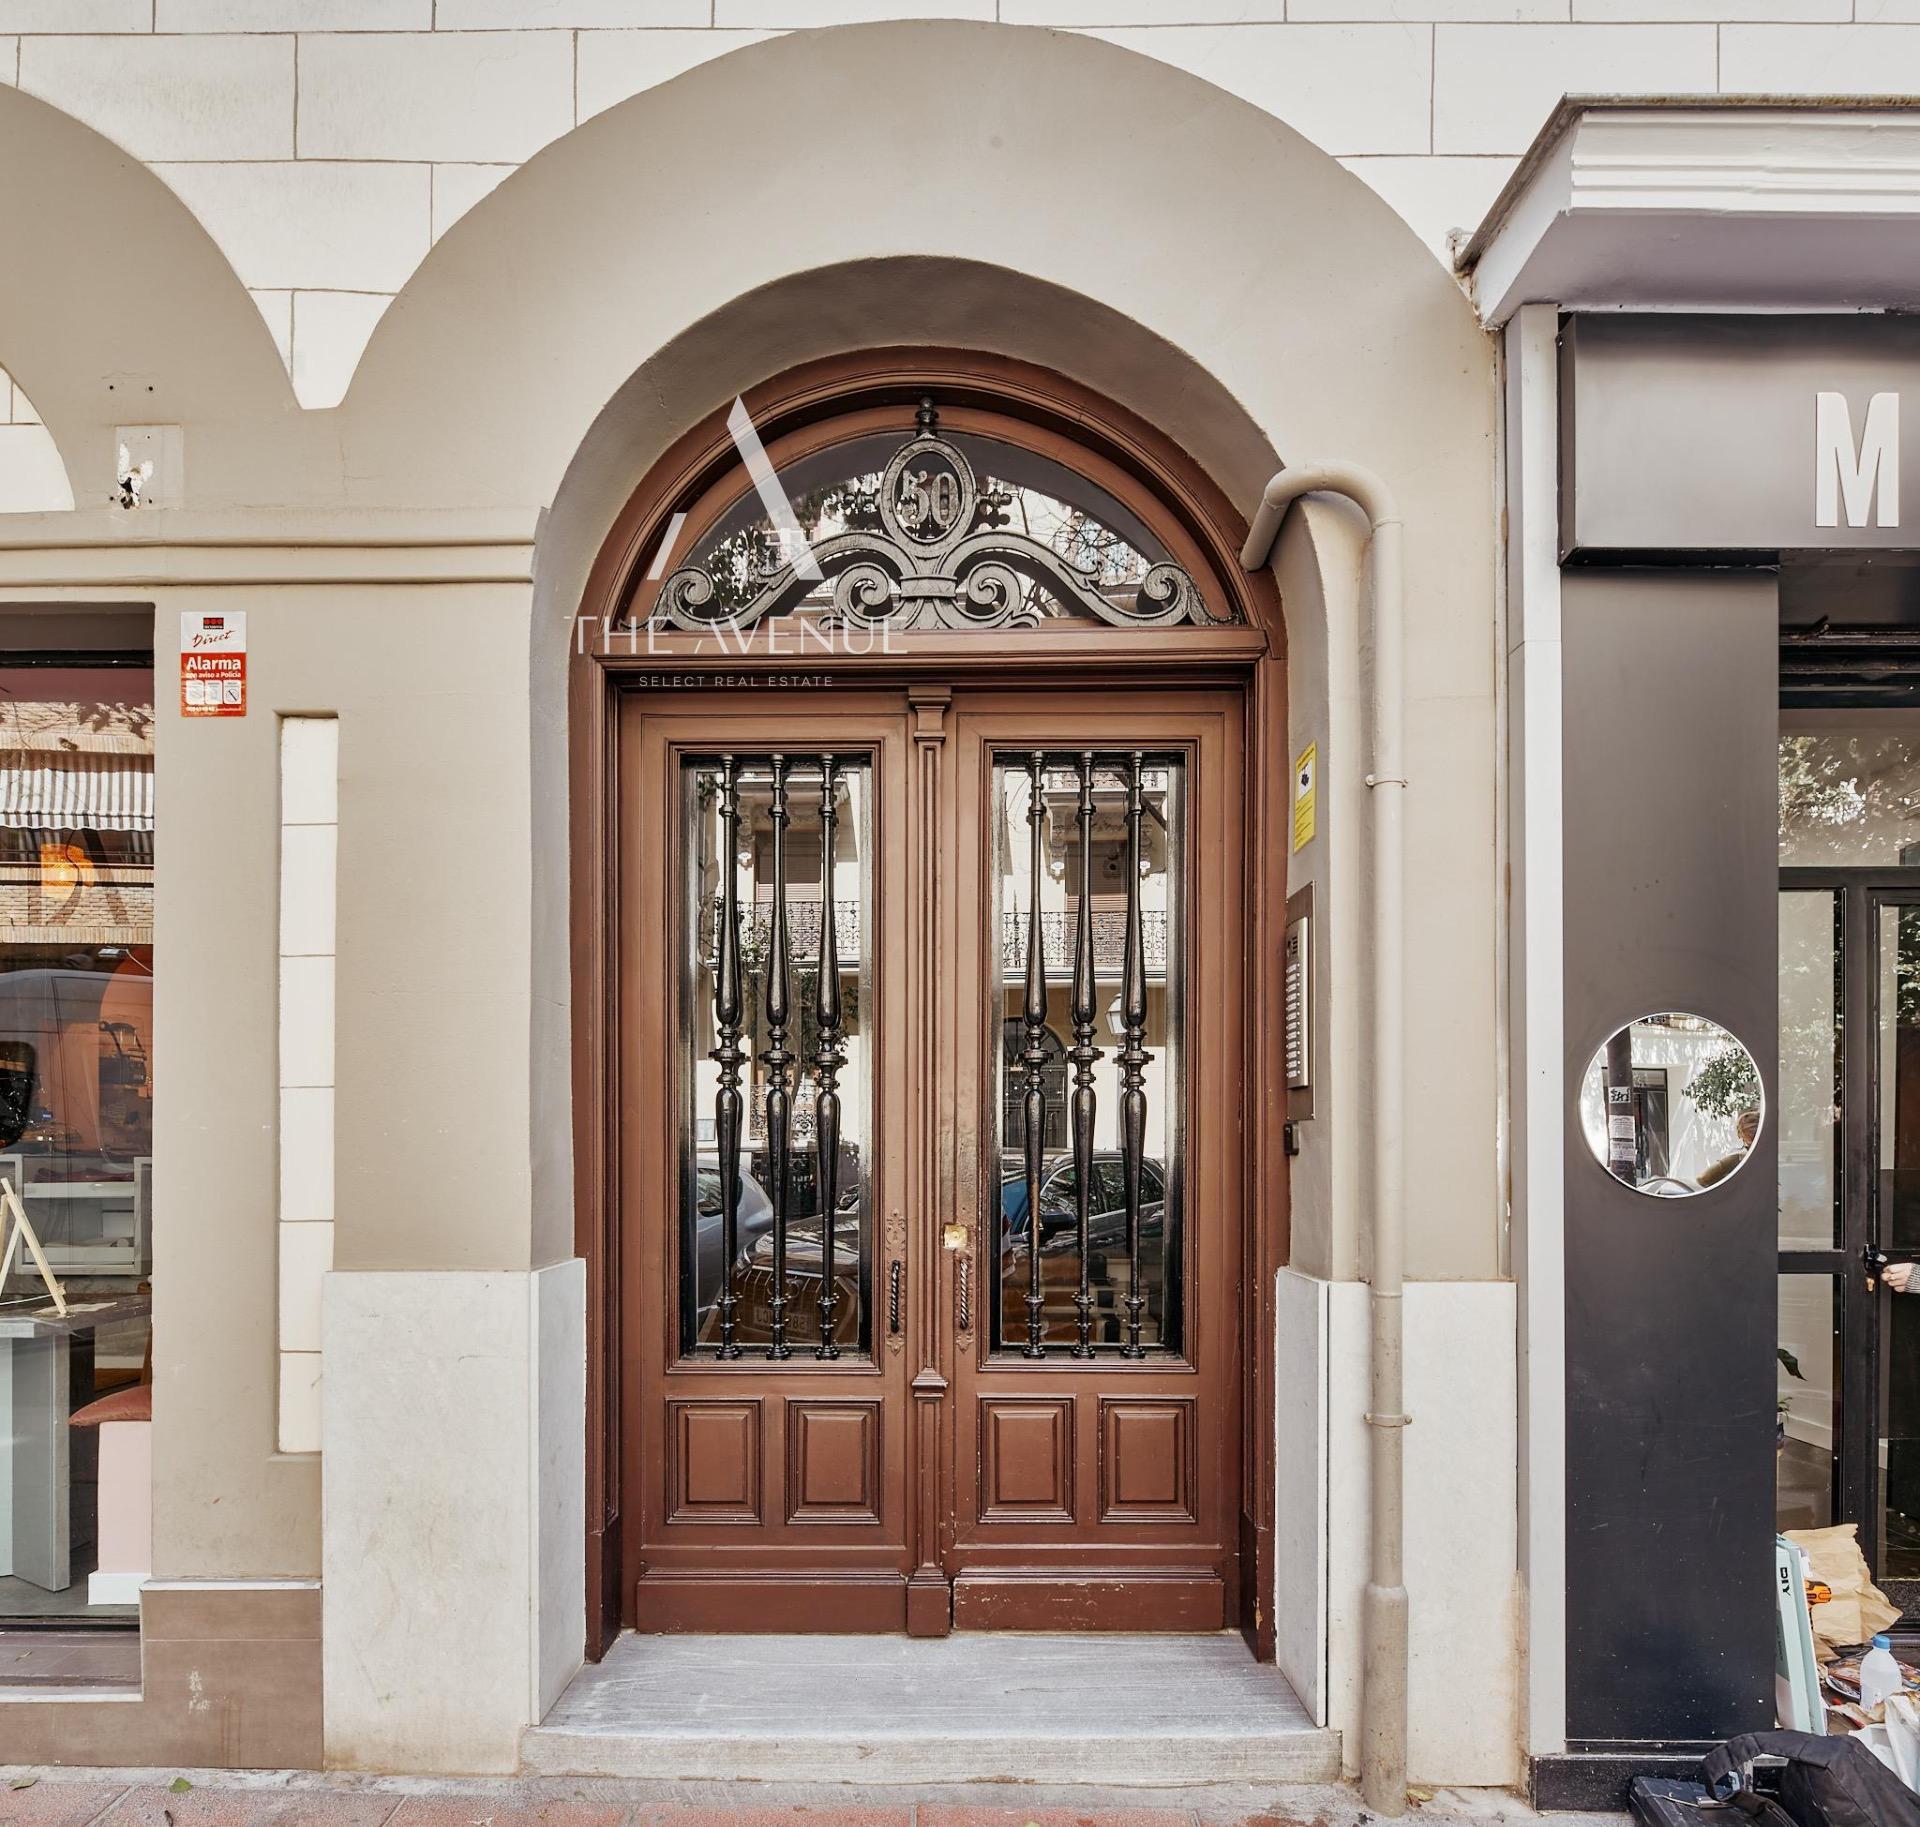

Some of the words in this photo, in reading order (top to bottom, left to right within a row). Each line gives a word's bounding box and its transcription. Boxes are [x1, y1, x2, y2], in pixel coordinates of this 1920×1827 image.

[1815, 391, 1900, 528] M
[901, 470, 960, 525] 50
[192, 629, 236, 648] Direct
[187, 656, 241, 670] Alarma
[1780, 1567, 1791, 1597] DIY
